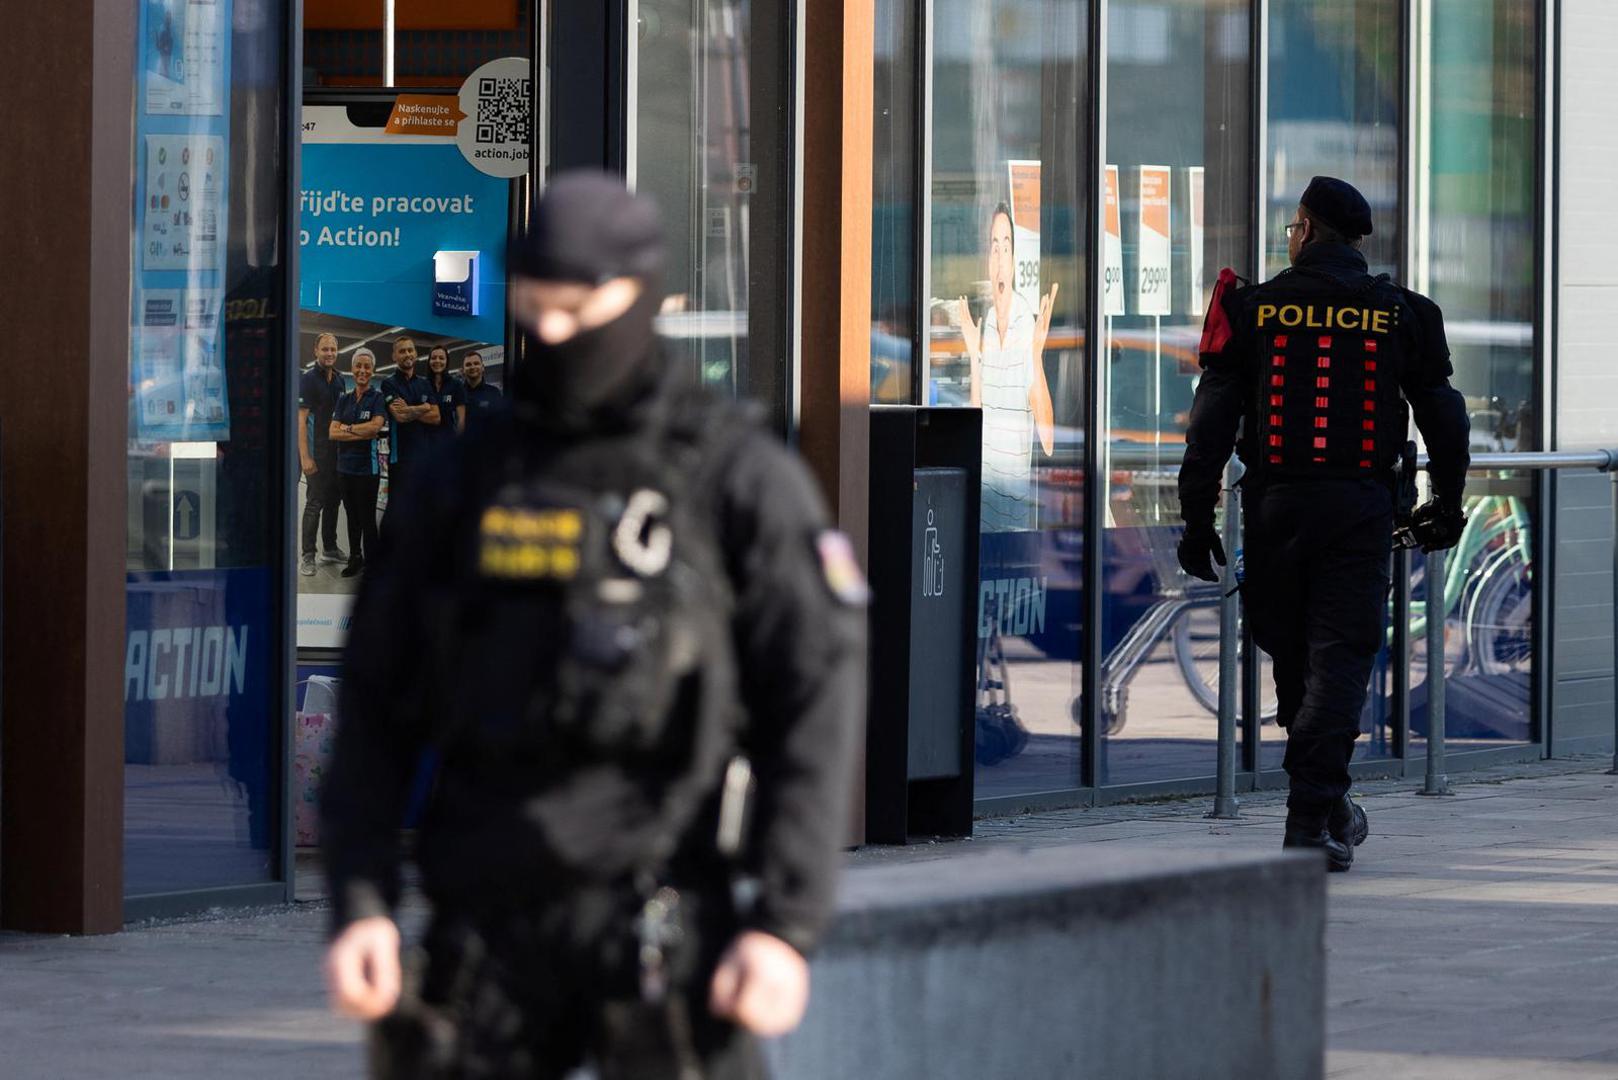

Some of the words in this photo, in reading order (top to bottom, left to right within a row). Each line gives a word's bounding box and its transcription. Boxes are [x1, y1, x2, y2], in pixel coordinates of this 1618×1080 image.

[393, 117, 400, 125] a
[398, 104, 450, 114] Naskenujte
[474, 148, 530, 161] action.job
[300, 190, 364, 217] řijďte
[372, 194, 474, 217] pracovat
[317, 225, 400, 246] Action!
[1257, 304, 1390, 333] POLICIE
[977, 576, 1048, 639] CTION
[124, 625, 249, 701] ACTION
